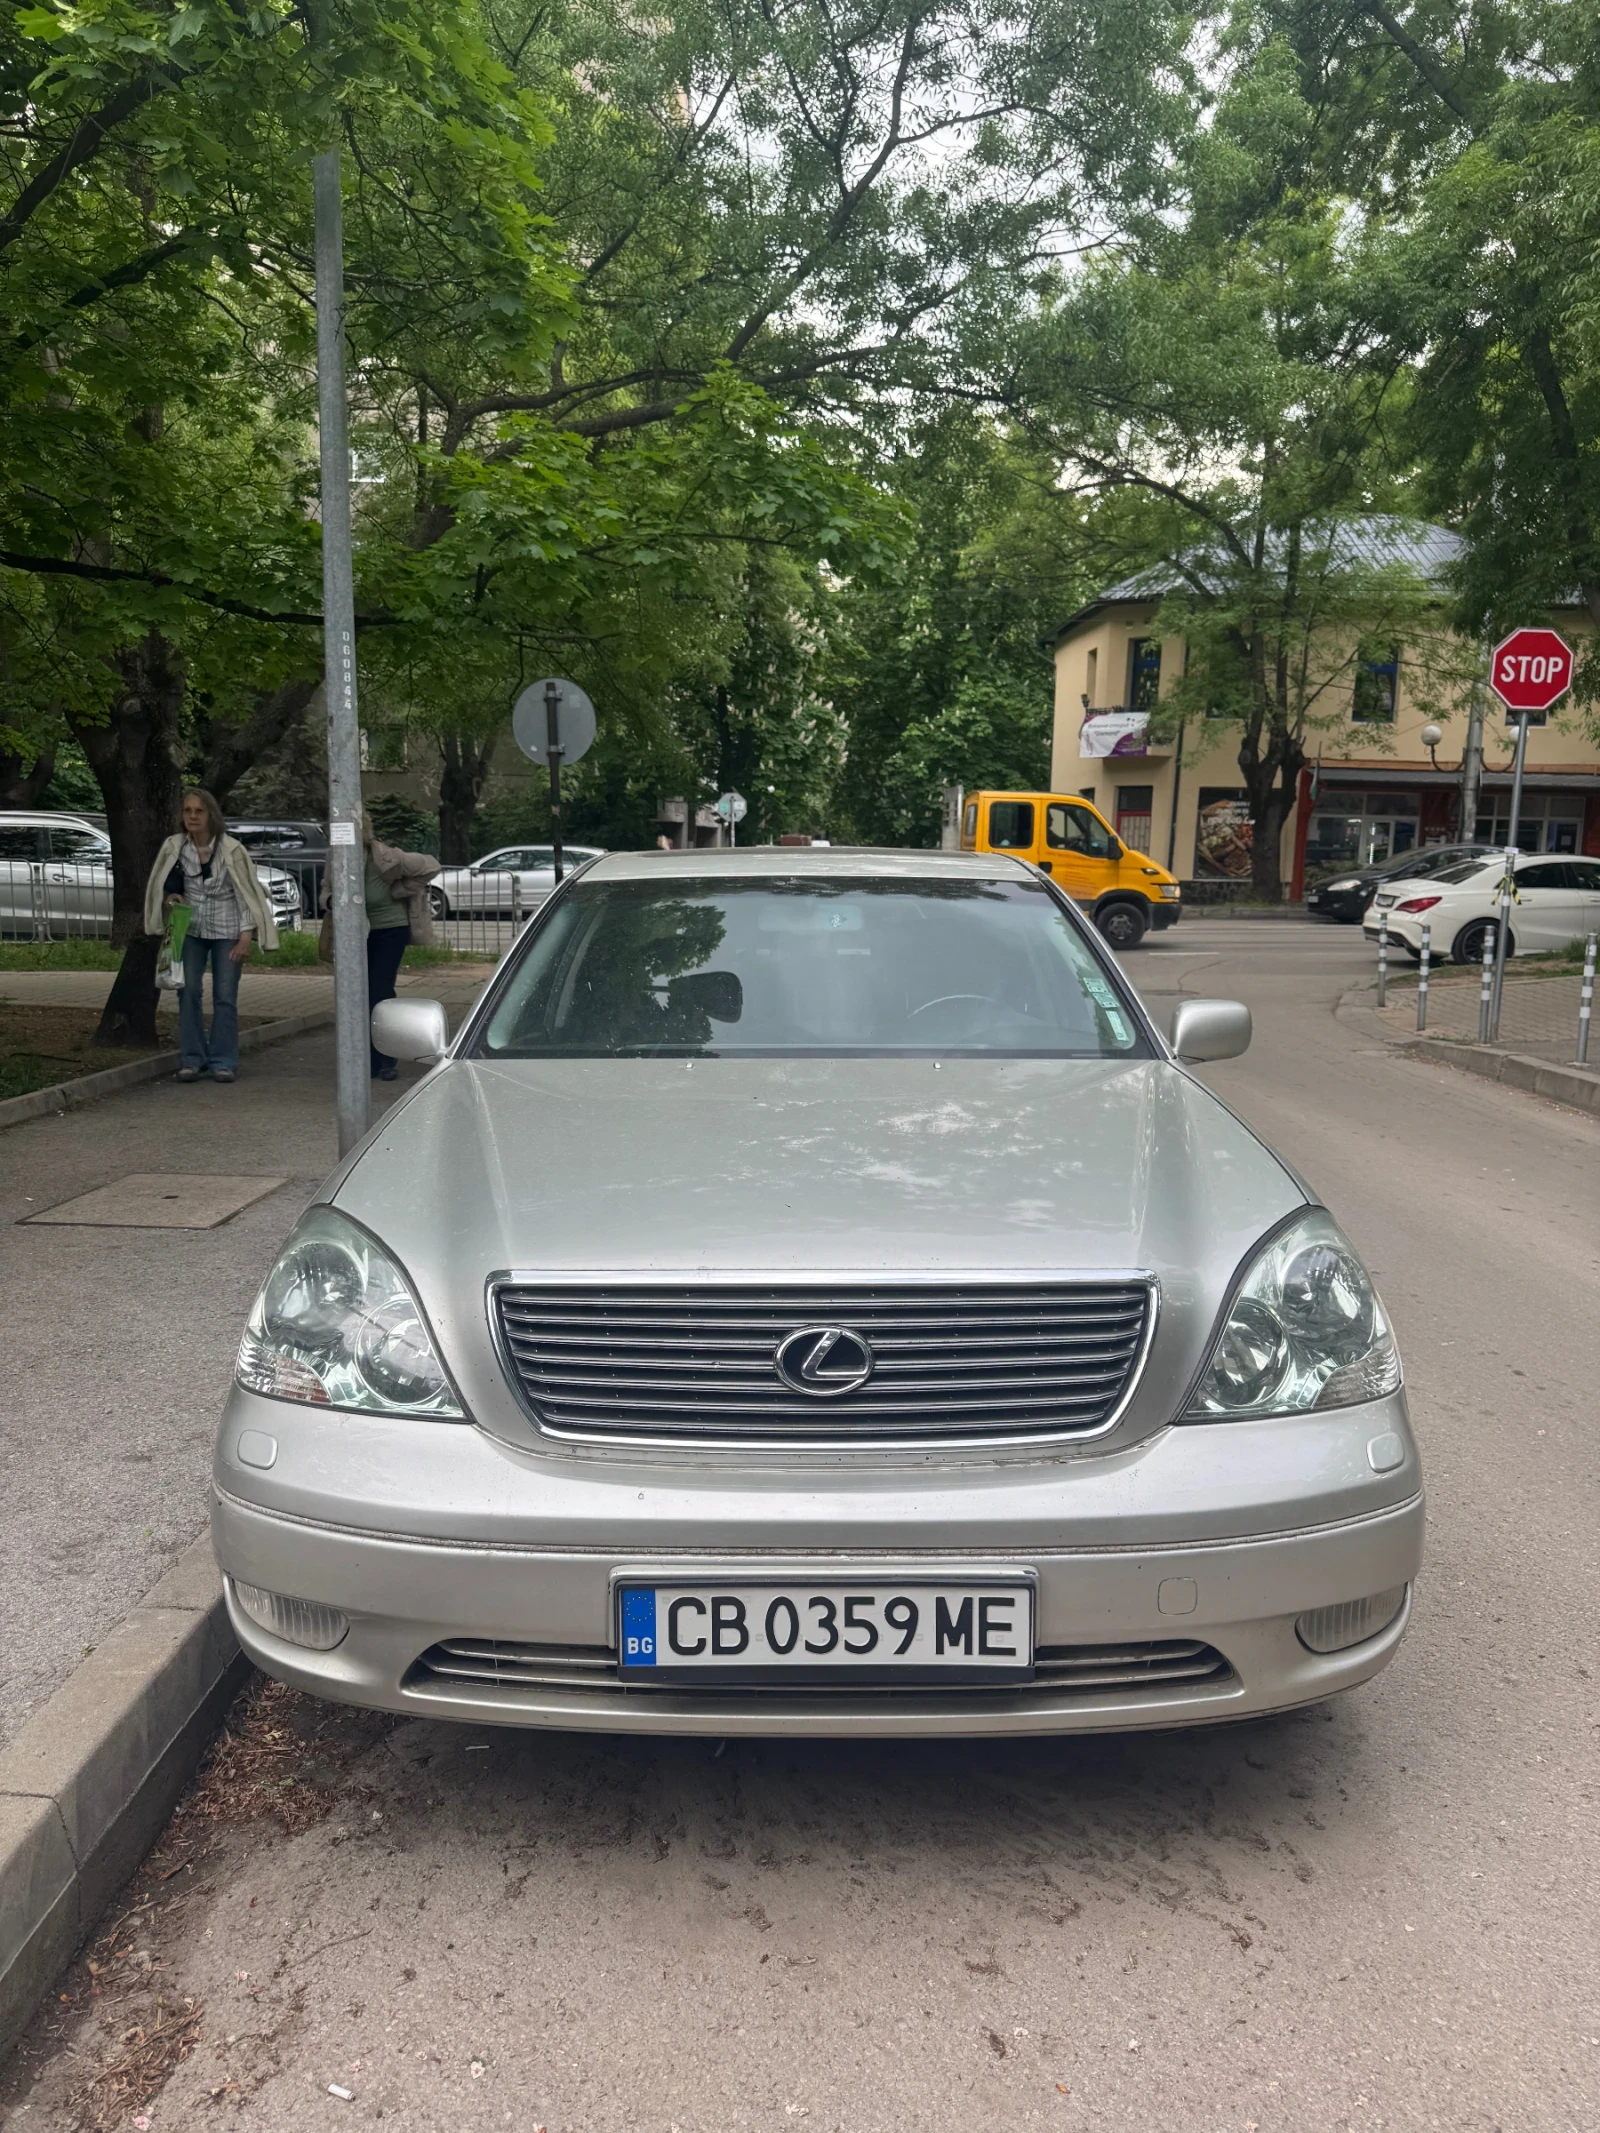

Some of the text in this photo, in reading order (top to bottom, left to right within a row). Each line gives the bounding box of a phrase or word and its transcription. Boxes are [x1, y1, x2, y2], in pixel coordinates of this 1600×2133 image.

[1500, 655, 1564, 683] STOP
[667, 1596, 1018, 1656] CB 0359 ME
[627, 1637, 654, 1655] BG
